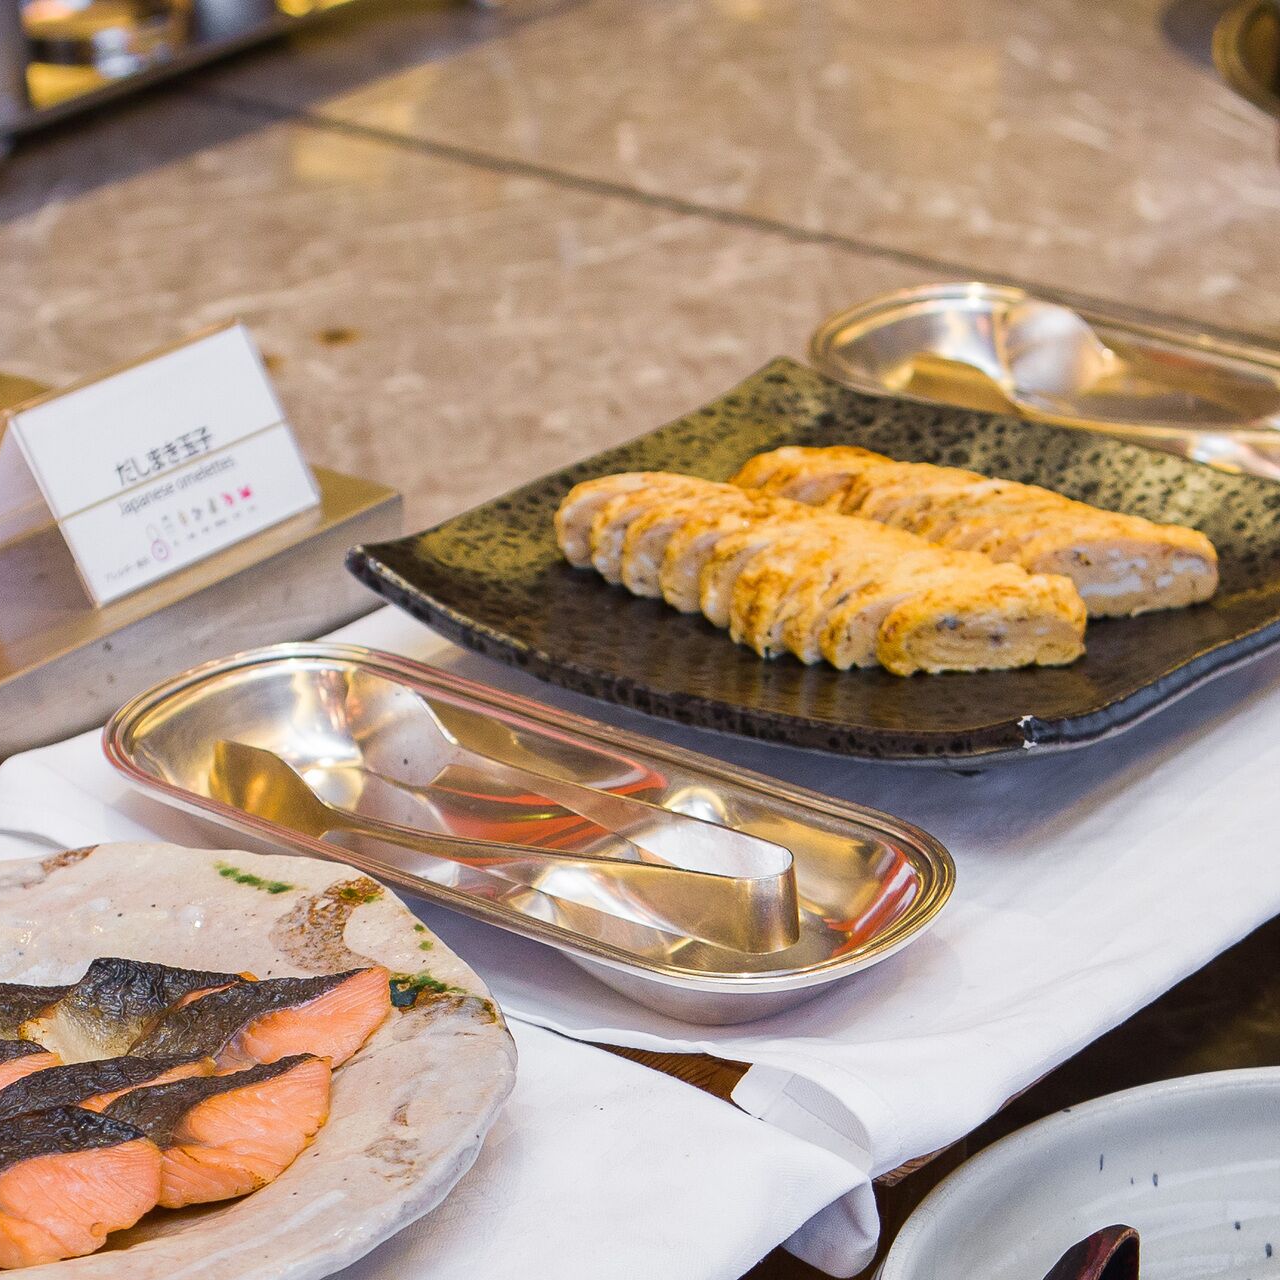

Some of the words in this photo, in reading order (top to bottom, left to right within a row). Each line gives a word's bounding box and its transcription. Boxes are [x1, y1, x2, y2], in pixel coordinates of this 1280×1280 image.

[116, 425, 213, 487] だしまき玉子
[120, 484, 176, 517] Japanese
